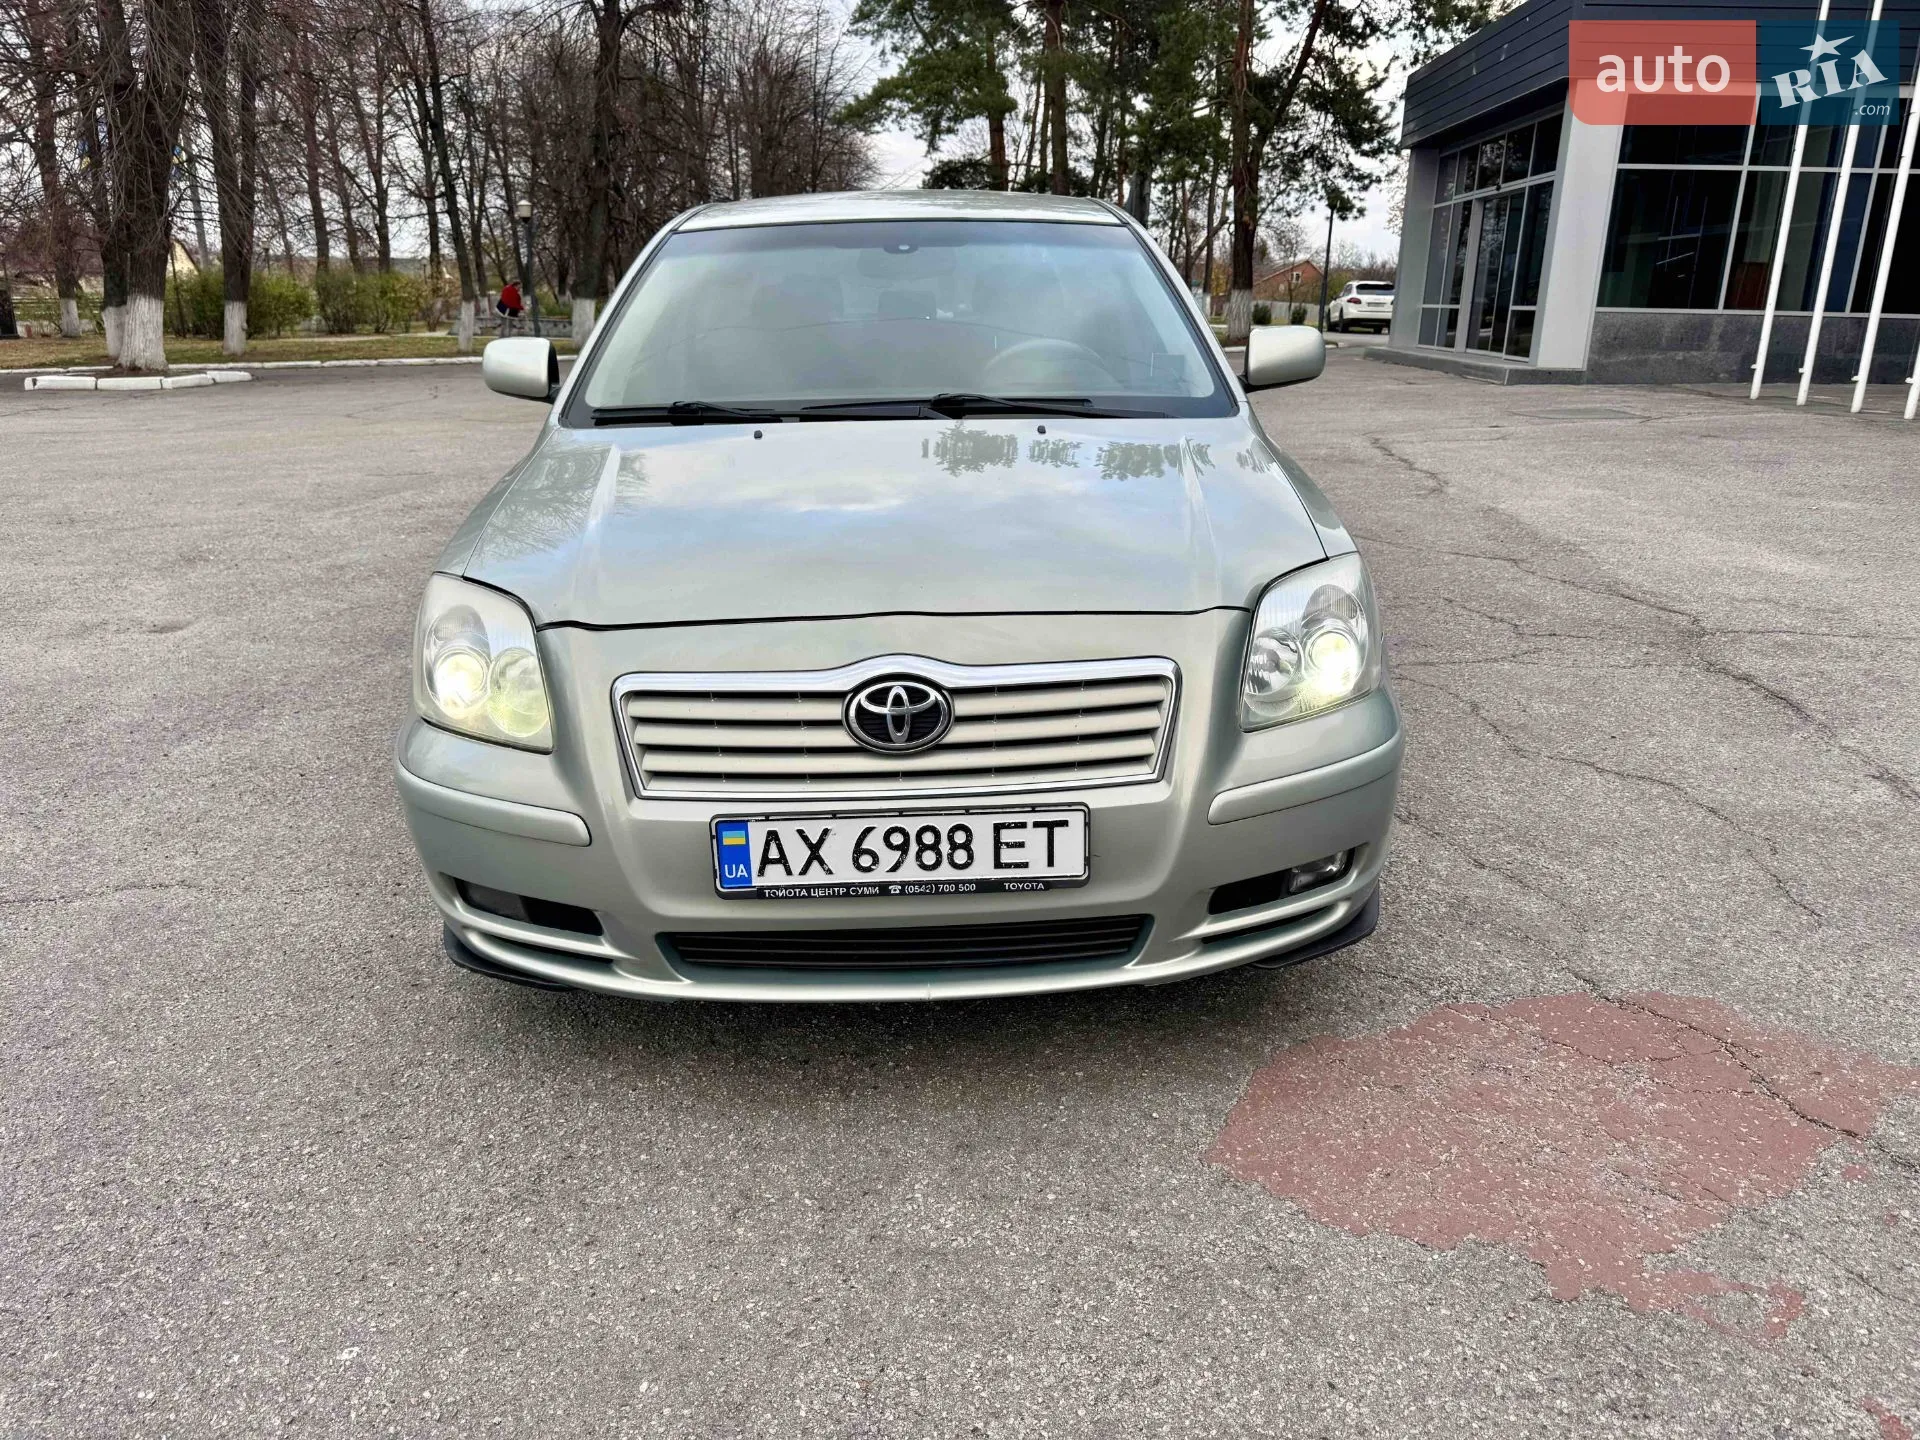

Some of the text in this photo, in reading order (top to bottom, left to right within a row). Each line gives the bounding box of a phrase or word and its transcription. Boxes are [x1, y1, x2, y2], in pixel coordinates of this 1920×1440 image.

[757, 819, 1070, 877] AX 6988 ET
[724, 863, 749, 879] UA
[764, 887, 809, 898] ТОЙОТА
[811, 887, 847, 898] ЦЕНТР
[904, 884, 936, 894] (0542)
[938, 884, 956, 893] 700
[958, 883, 976, 892] 500
[1003, 882, 1045, 891] TOYOTA
